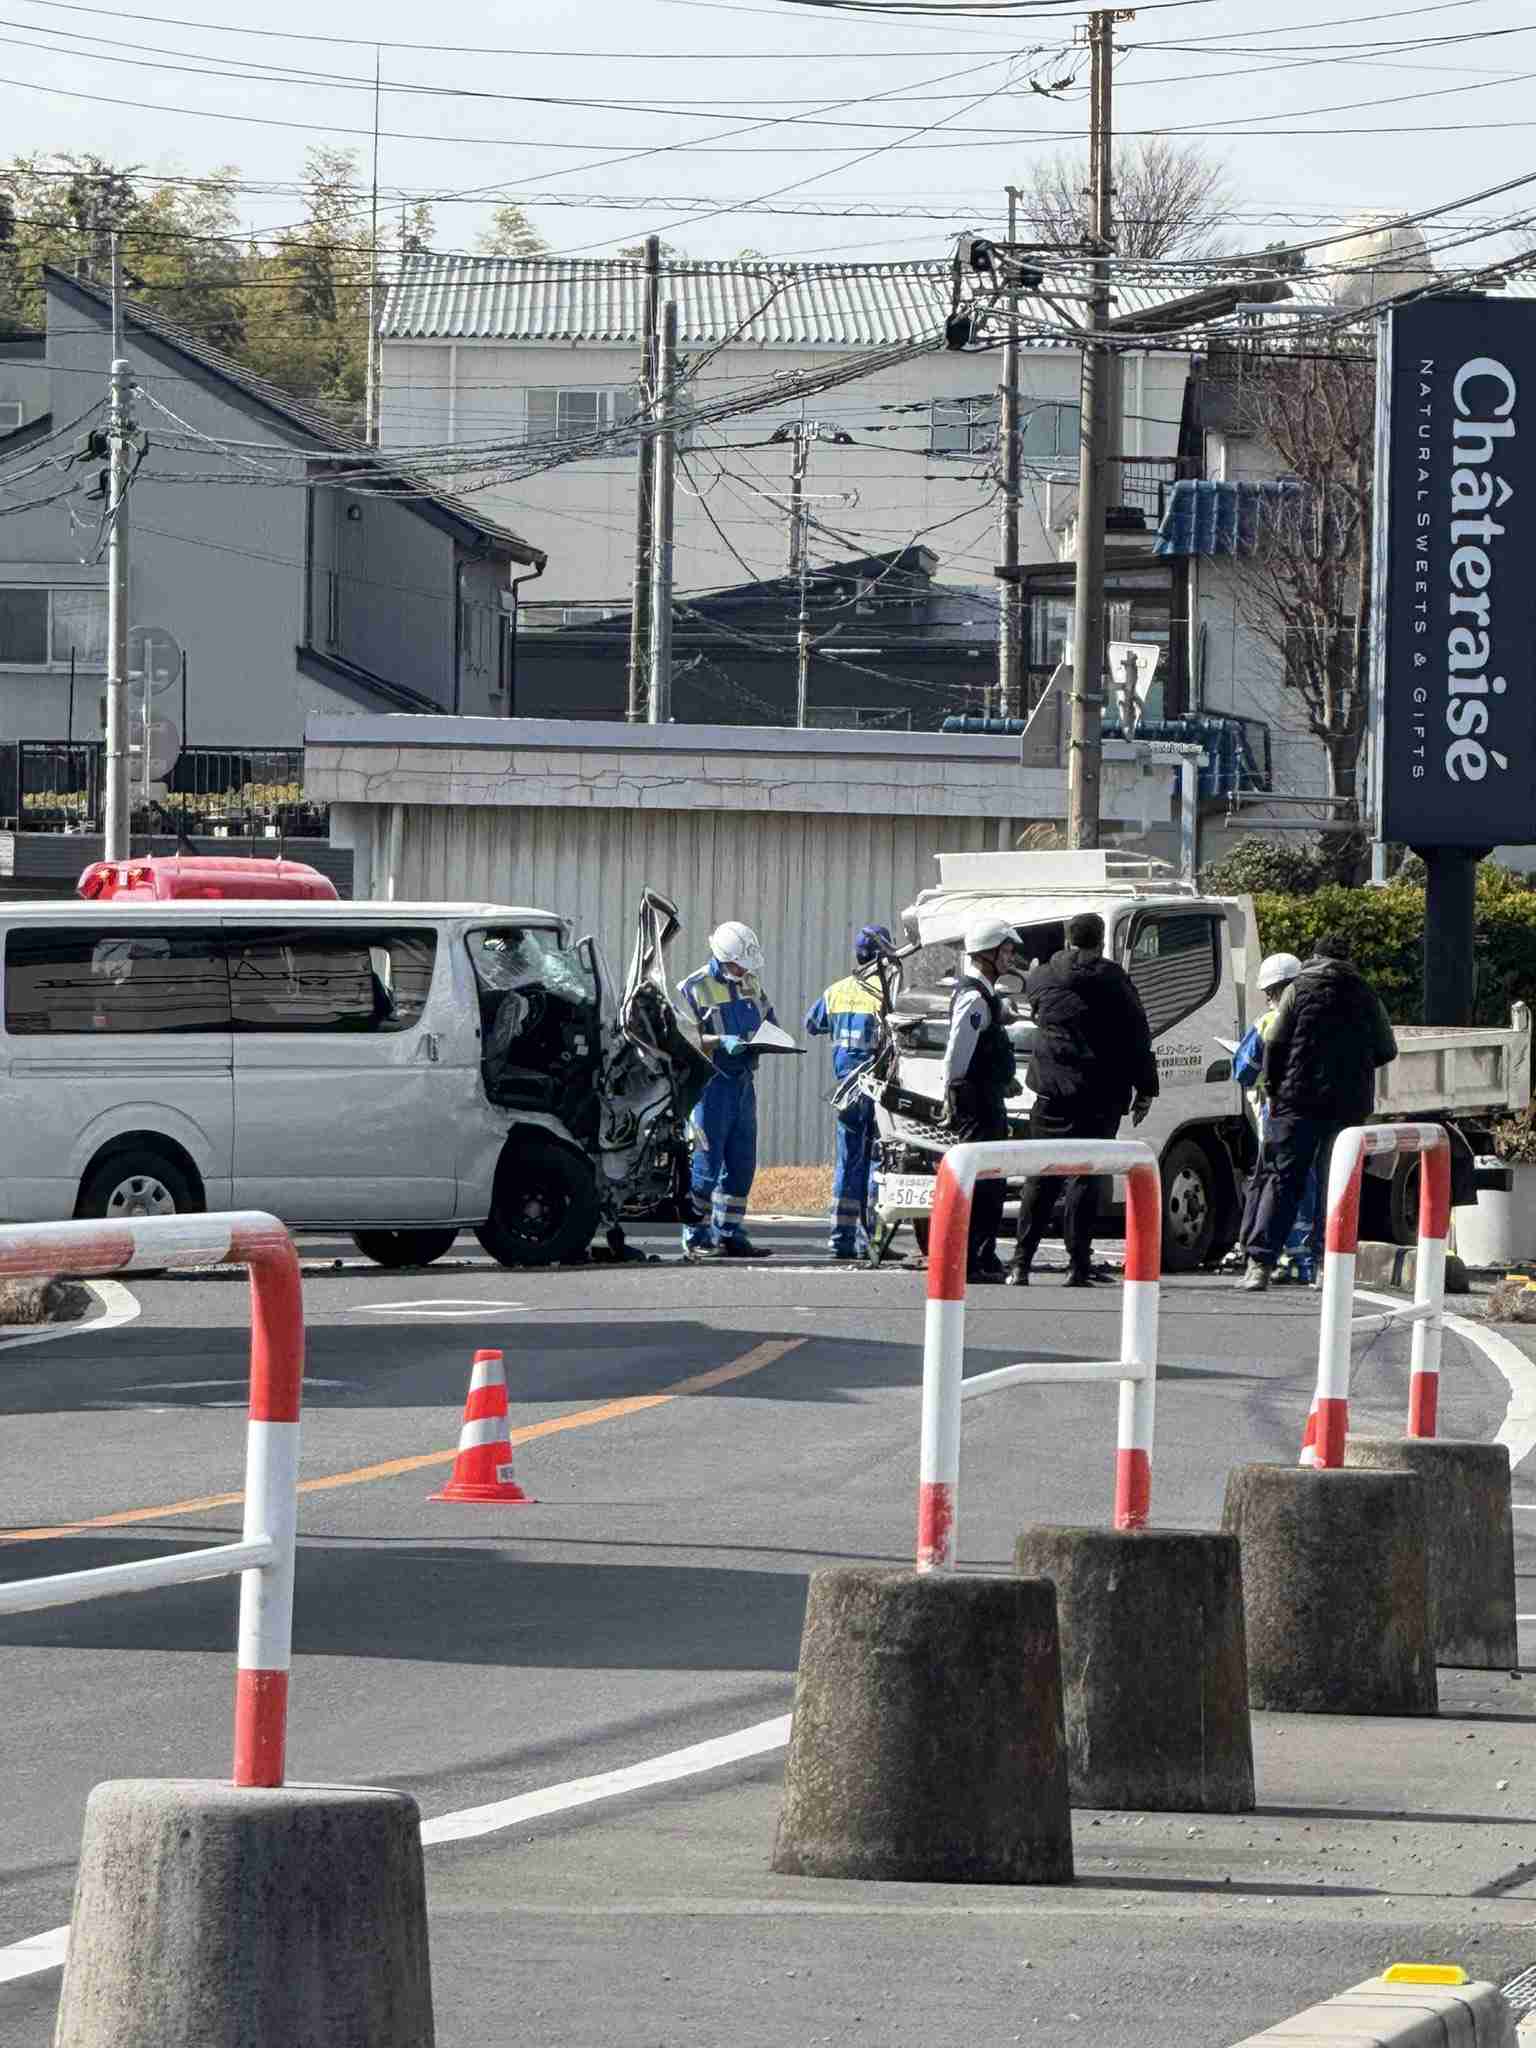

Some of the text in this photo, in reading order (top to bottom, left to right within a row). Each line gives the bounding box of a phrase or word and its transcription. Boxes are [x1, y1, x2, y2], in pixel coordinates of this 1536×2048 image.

[1412, 359, 1434, 778] NATURAL SWEETS & GIFTS
[1444, 357, 1517, 782] Châteraisé
